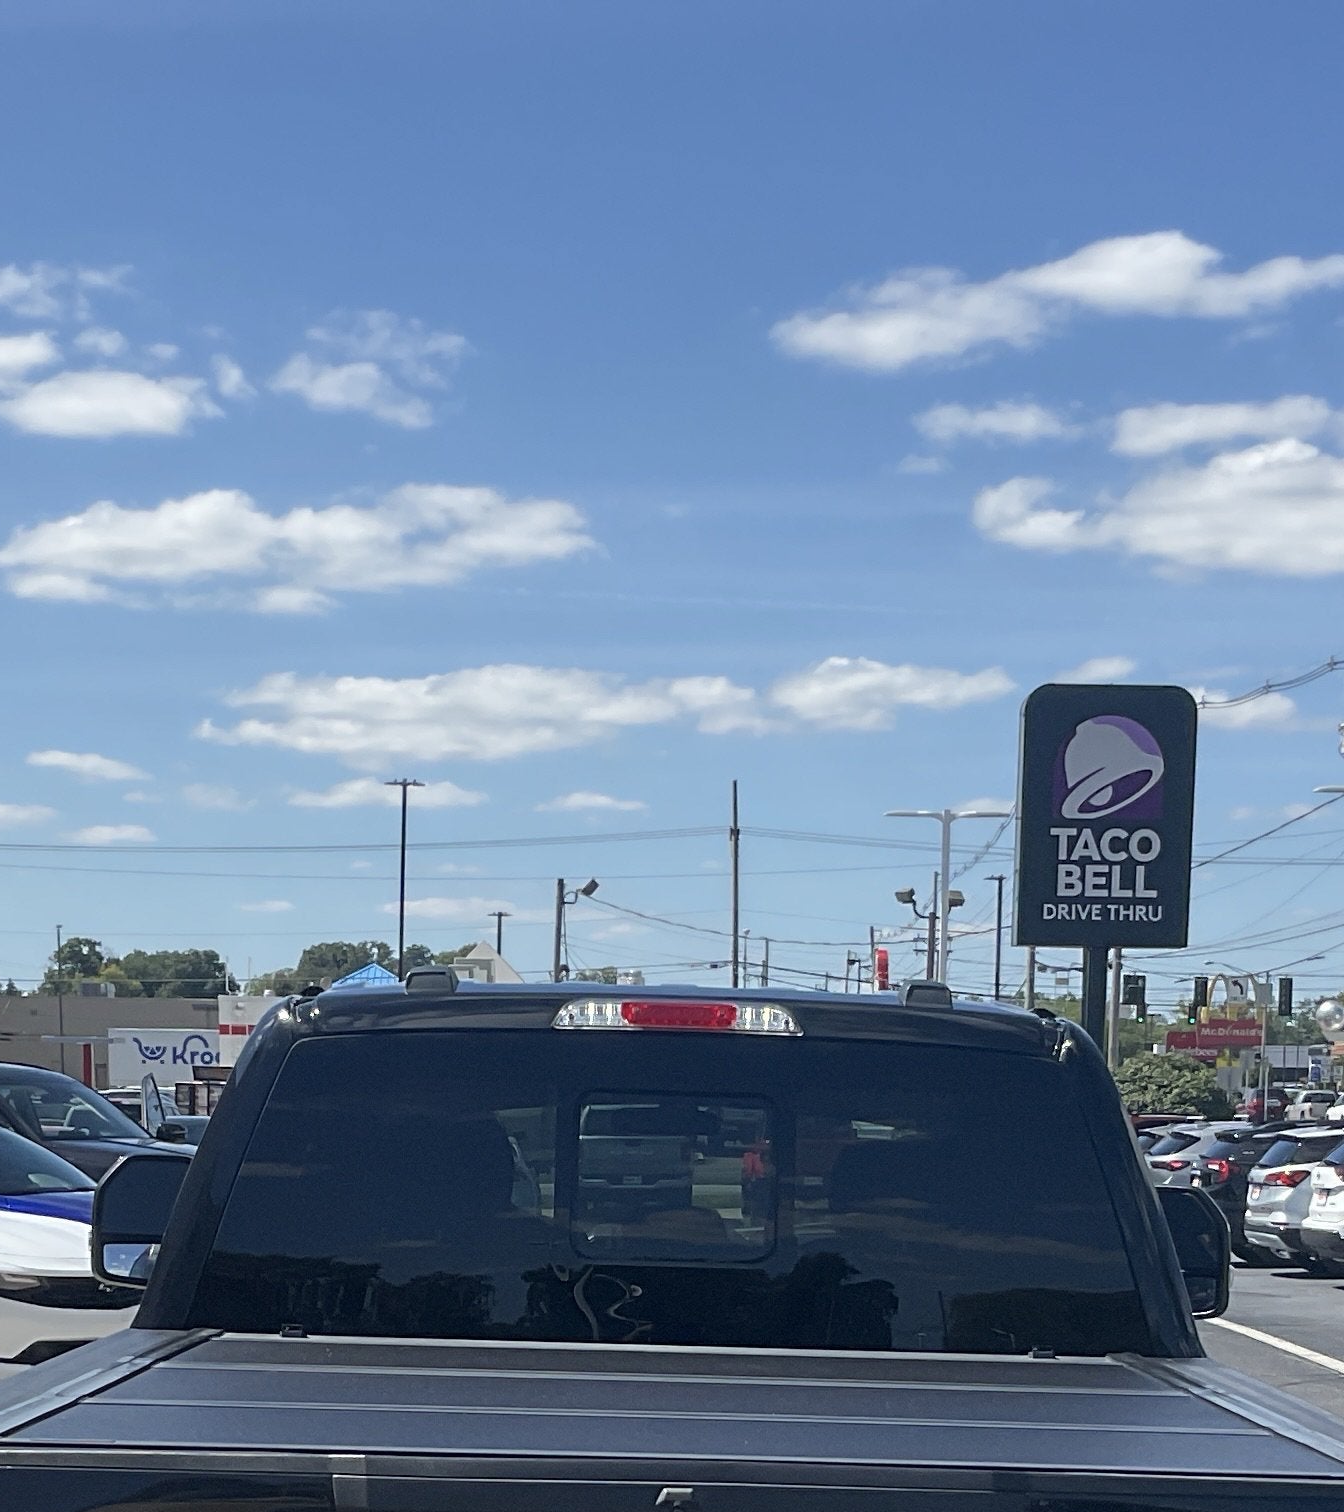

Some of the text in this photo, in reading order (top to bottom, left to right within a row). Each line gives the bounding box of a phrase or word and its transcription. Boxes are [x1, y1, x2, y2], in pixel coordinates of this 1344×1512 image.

[1050, 827, 1162, 863] TACO
[1056, 863, 1158, 898] BELL
[1042, 903, 1163, 922] DRIVE THRU
